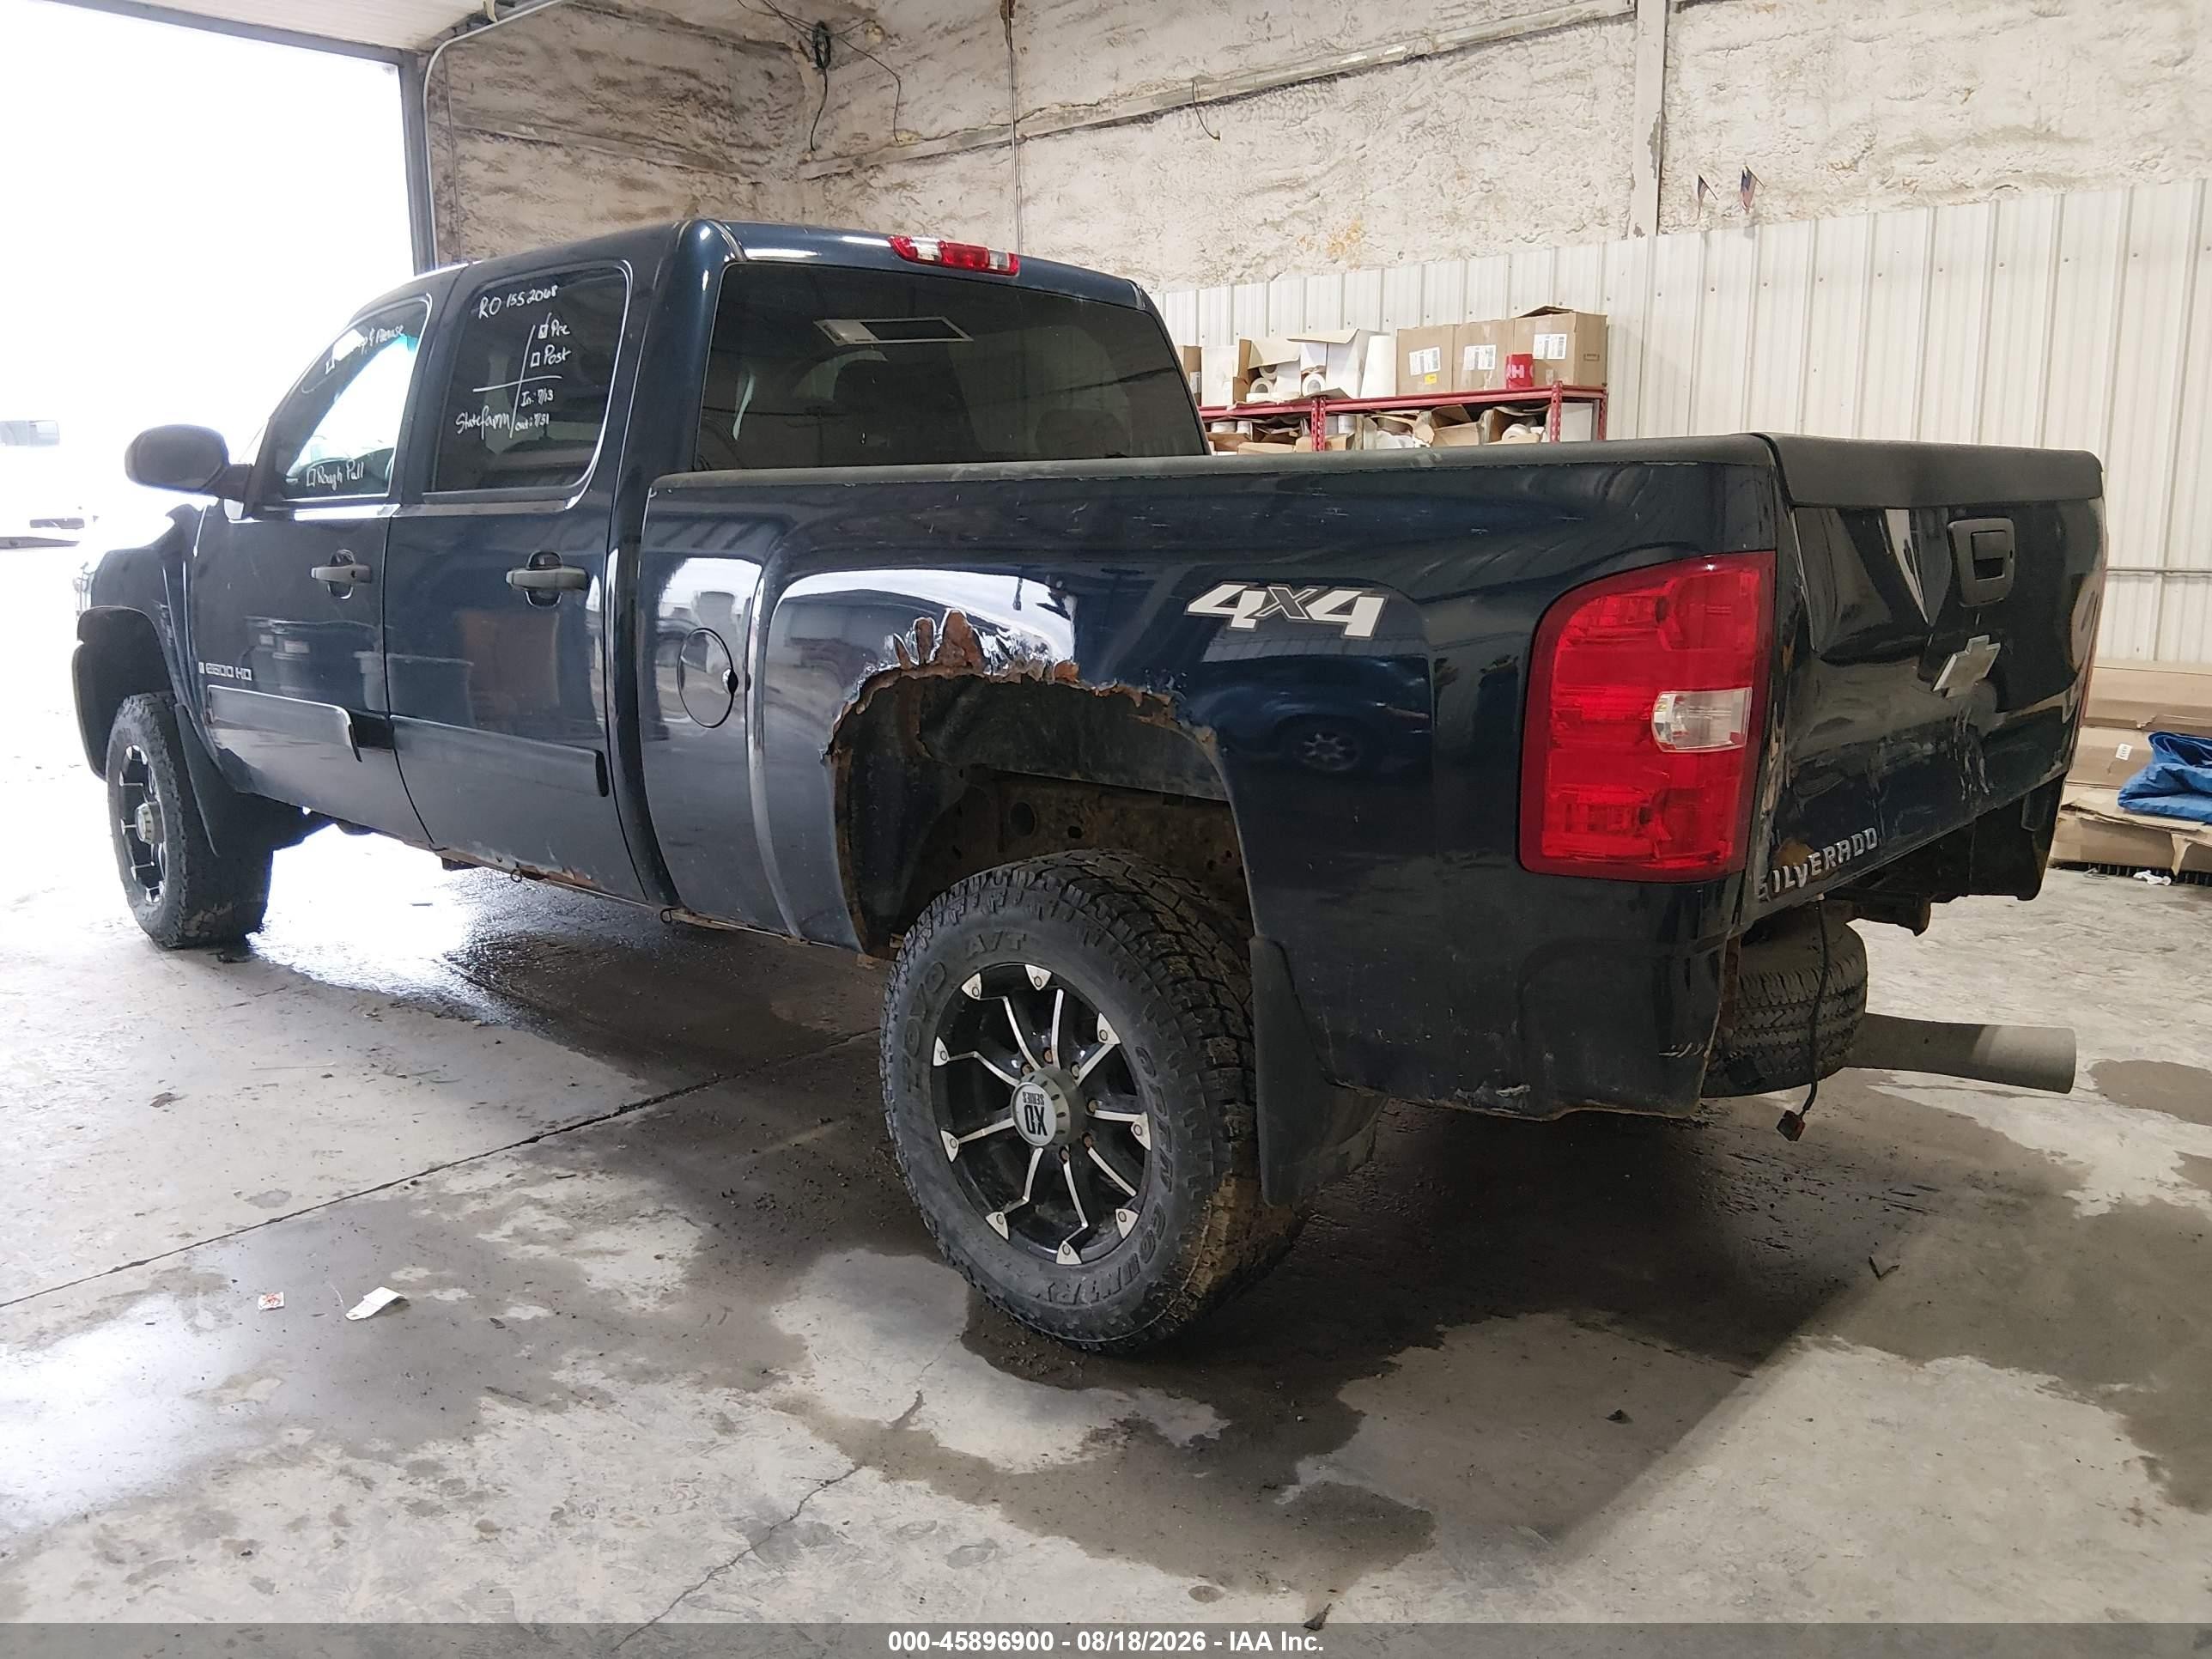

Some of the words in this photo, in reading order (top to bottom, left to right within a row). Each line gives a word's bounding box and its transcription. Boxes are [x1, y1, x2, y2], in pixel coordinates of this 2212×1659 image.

[477, 295, 502, 320] RO
[543, 343, 572, 366] Post
[1758, 826, 1879, 902] SILVERADO
[1023, 1104, 1048, 1137] XD
